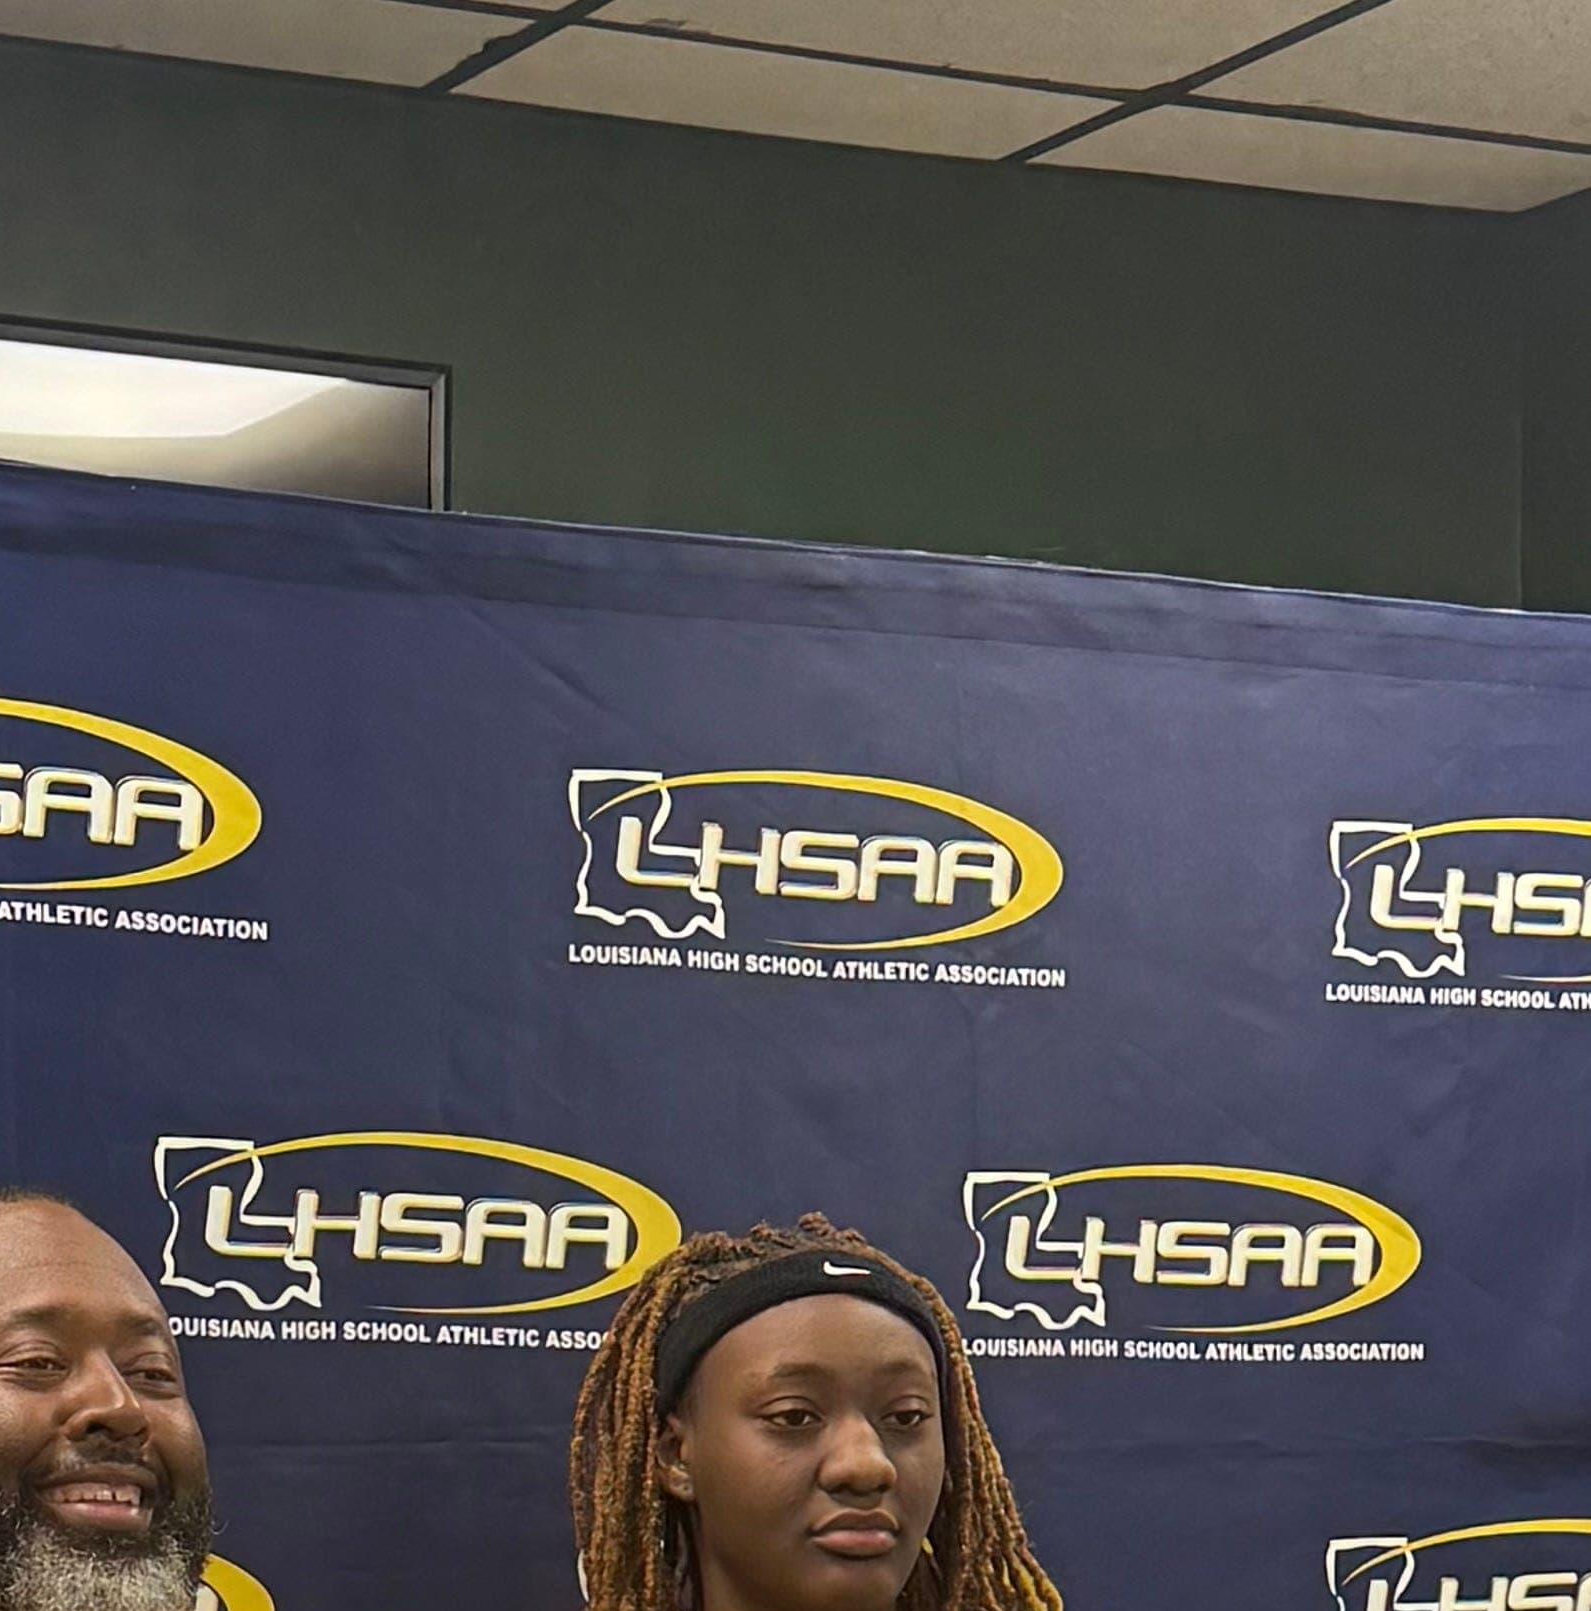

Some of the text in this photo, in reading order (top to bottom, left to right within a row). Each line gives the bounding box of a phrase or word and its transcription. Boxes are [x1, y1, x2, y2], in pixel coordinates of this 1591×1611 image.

[615, 815, 1014, 908] LHSAA
[1370, 864, 1591, 938] LHS
[114, 910, 268, 941] ASSOCIATION
[568, 943, 1066, 988] LOUISIANA HIGH SCHOOL ATHLETIC ASSOCIATION
[1325, 983, 1426, 1005] LOUISIANA
[1429, 987, 1477, 1006] HIGH
[1480, 988, 1557, 1009] SCHOOL
[205, 1185, 630, 1271] LHSAA
[1005, 1214, 1377, 1289] LHSAA
[168, 1316, 276, 1342] OUISIANA
[281, 1320, 337, 1341] HIGH
[342, 1321, 432, 1343] SCHOOL
[436, 1325, 540, 1348] ATHLETIC
[962, 1338, 1424, 1362] LOUISIANA HIGH SCHOOL ATHLETIC ASSOCIATION
